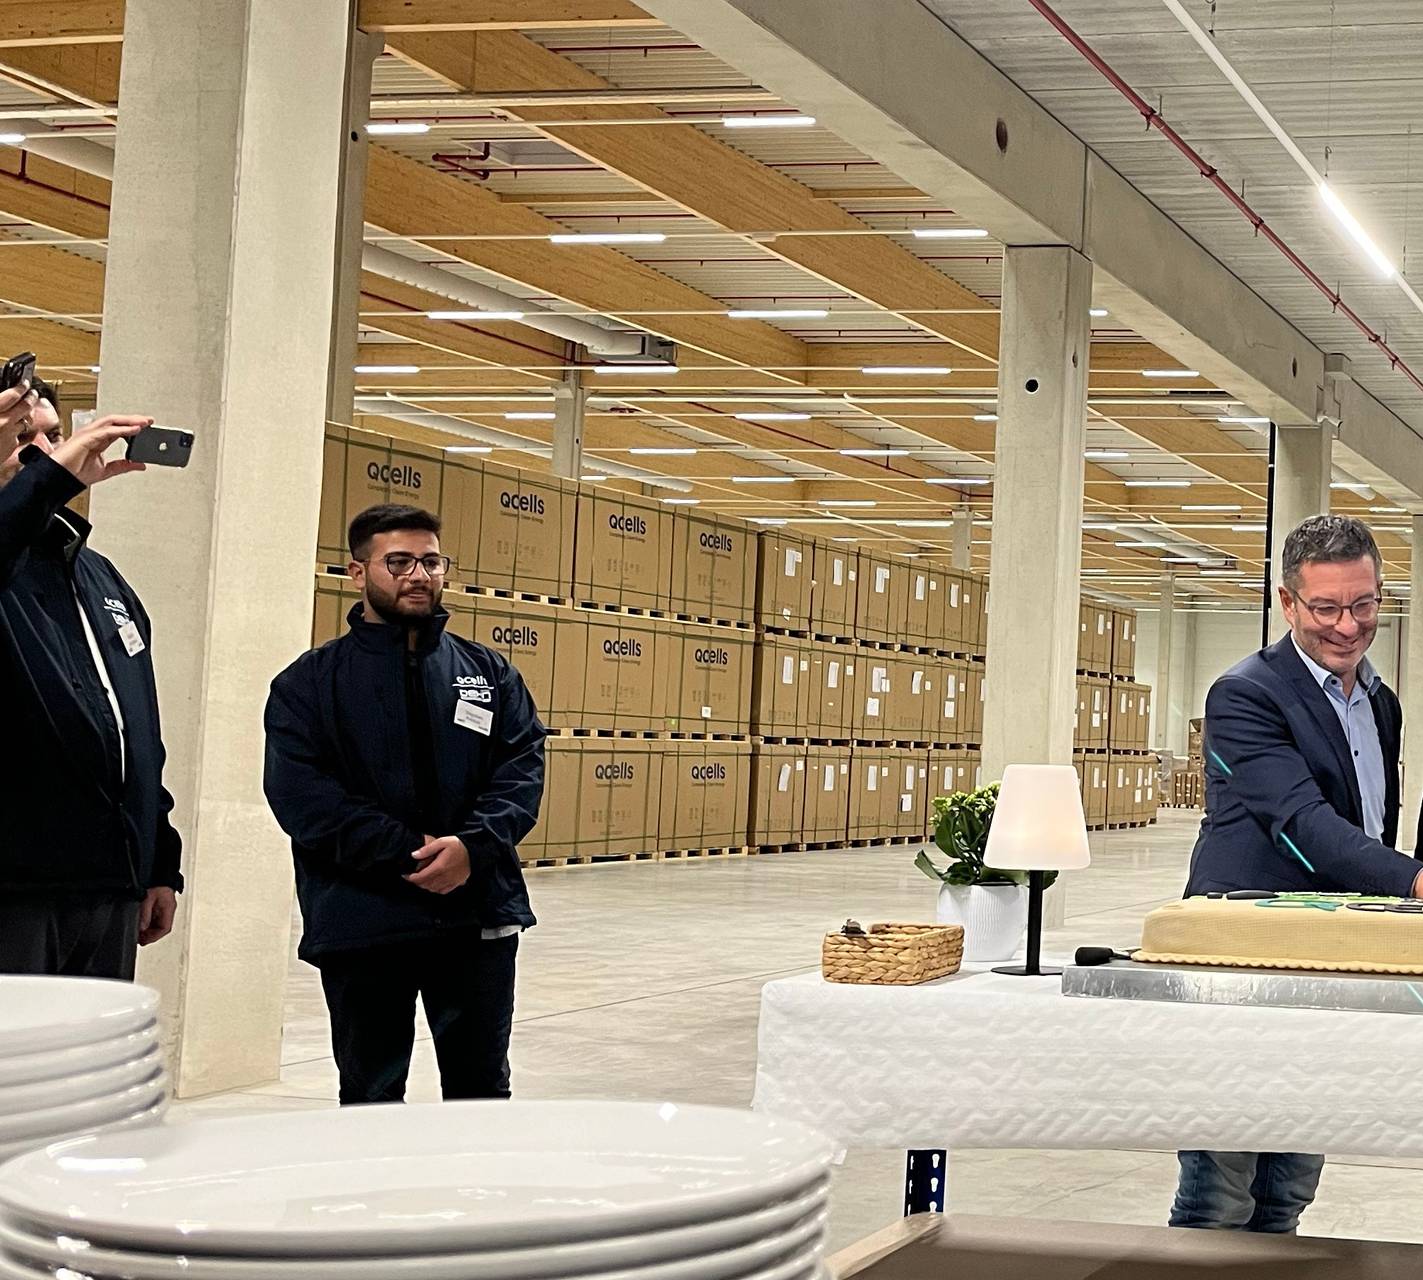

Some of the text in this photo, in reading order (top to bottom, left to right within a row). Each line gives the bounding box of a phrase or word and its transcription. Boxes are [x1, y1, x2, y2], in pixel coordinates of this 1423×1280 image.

[367, 462, 422, 489] Qcells
[500, 491, 545, 515] Qcells
[608, 514, 647, 535] Qcells
[700, 532, 732, 552] Qcells
[492, 626, 538, 647] Qcells
[603, 638, 642, 657] Qcells
[694, 648, 728, 665] Qcells
[595, 762, 634, 780] Qcells
[691, 763, 726, 780] Qcells
